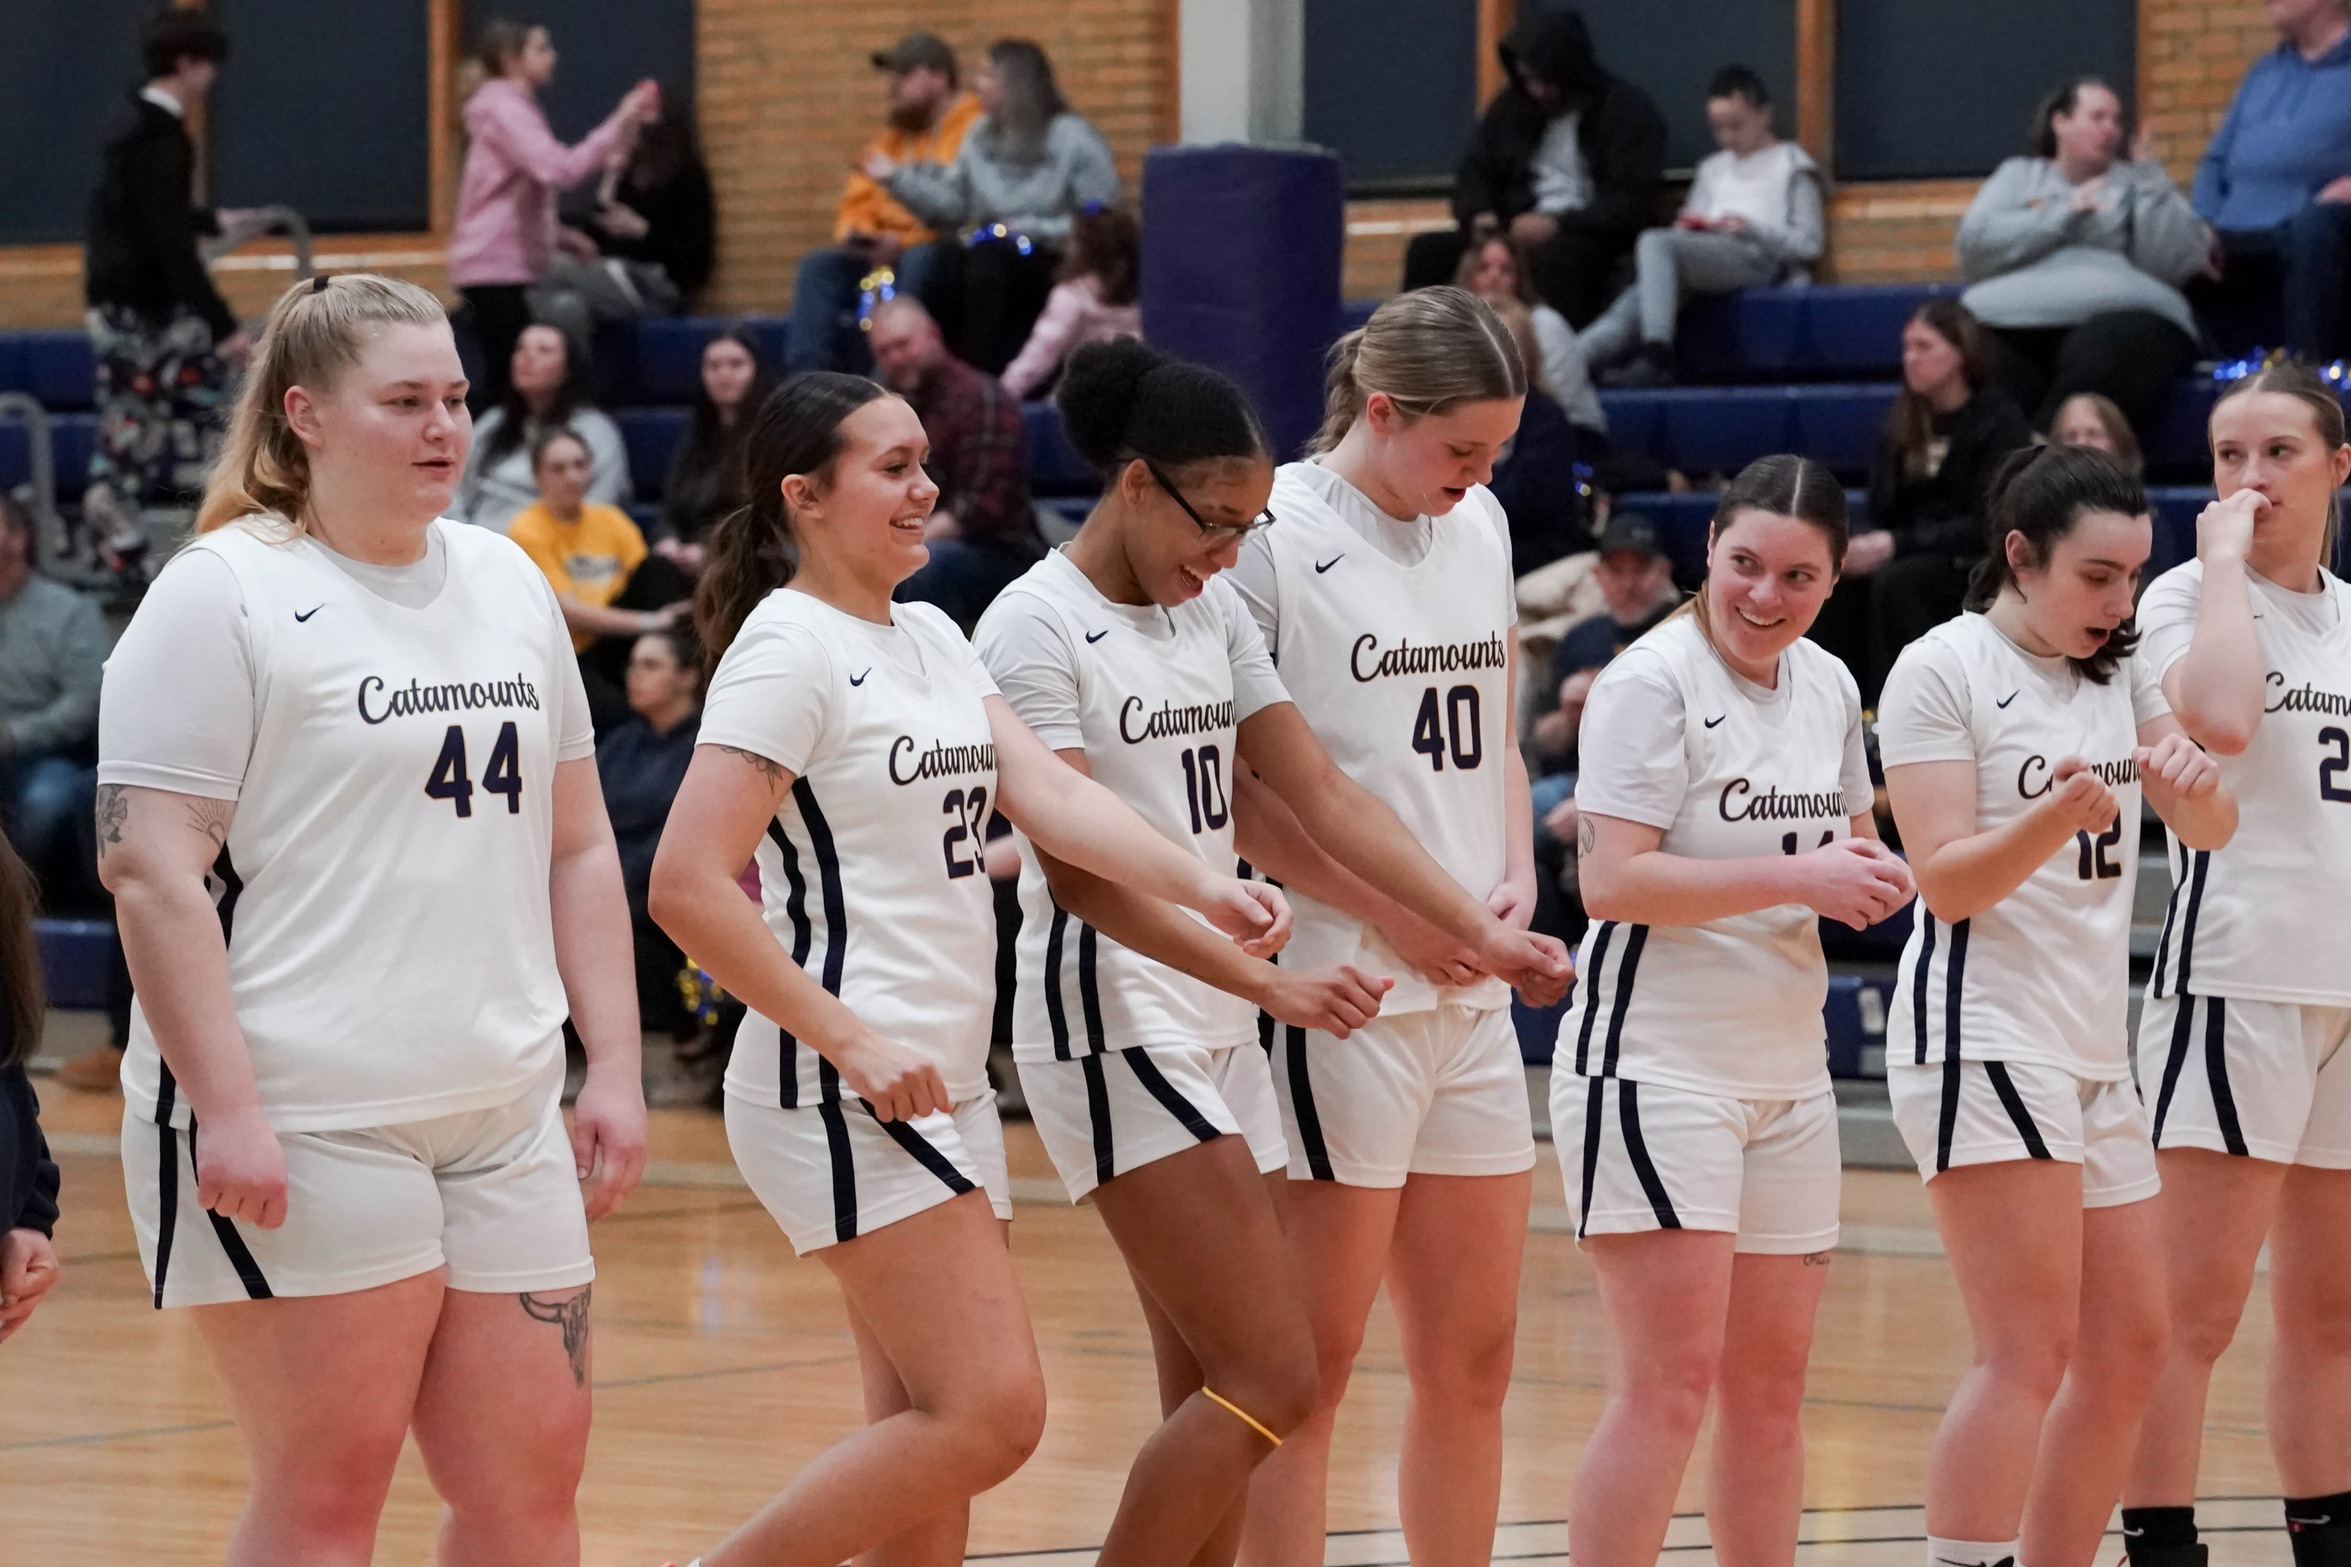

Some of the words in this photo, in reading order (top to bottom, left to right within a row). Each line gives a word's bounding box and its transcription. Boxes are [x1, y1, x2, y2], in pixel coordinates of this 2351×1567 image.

[1351, 630, 1505, 682] Catamounts
[358, 673, 539, 724] Catamounts
[1412, 685, 1482, 771] 40
[2264, 671, 2351, 717] Catam
[425, 721, 523, 818] 44
[1181, 744, 1228, 834] 10
[1719, 778, 1848, 822] Catamoun
[943, 786, 988, 880] 23
[2076, 807, 2122, 880] 12
